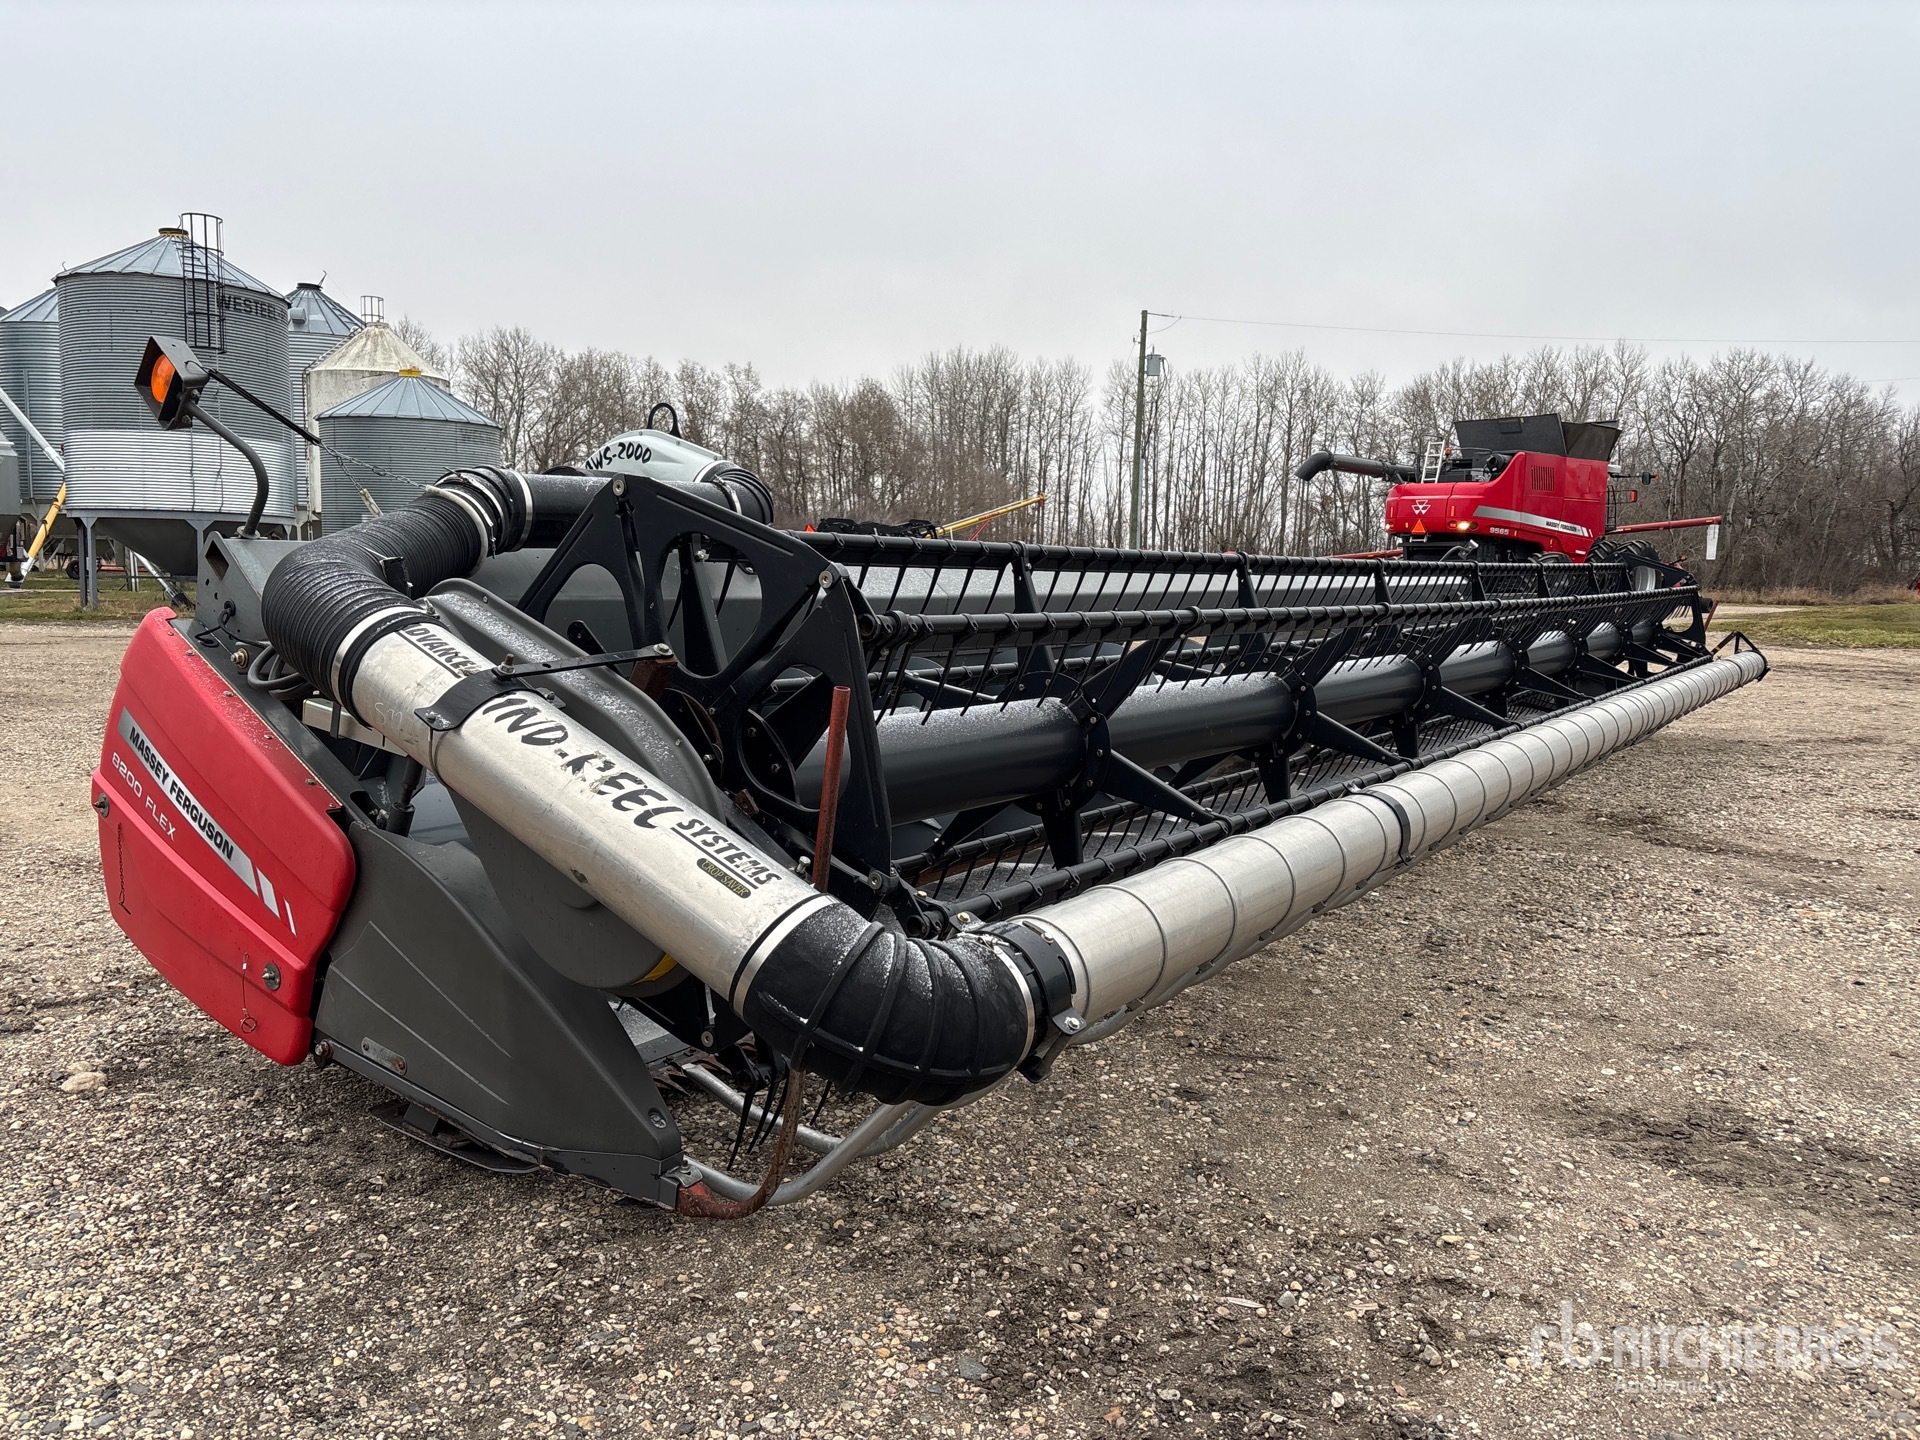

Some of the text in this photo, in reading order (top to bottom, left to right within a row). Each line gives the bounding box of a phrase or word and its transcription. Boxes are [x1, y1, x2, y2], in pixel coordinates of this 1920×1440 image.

[1489, 527, 1510, 536] 9565
[111, 751, 177, 842] 8200 FLEX
[129, 726, 234, 861] MASSEY FERGUSON
[675, 818, 782, 885] SYSTEMS
[701, 860, 749, 896] CROP SAVER
